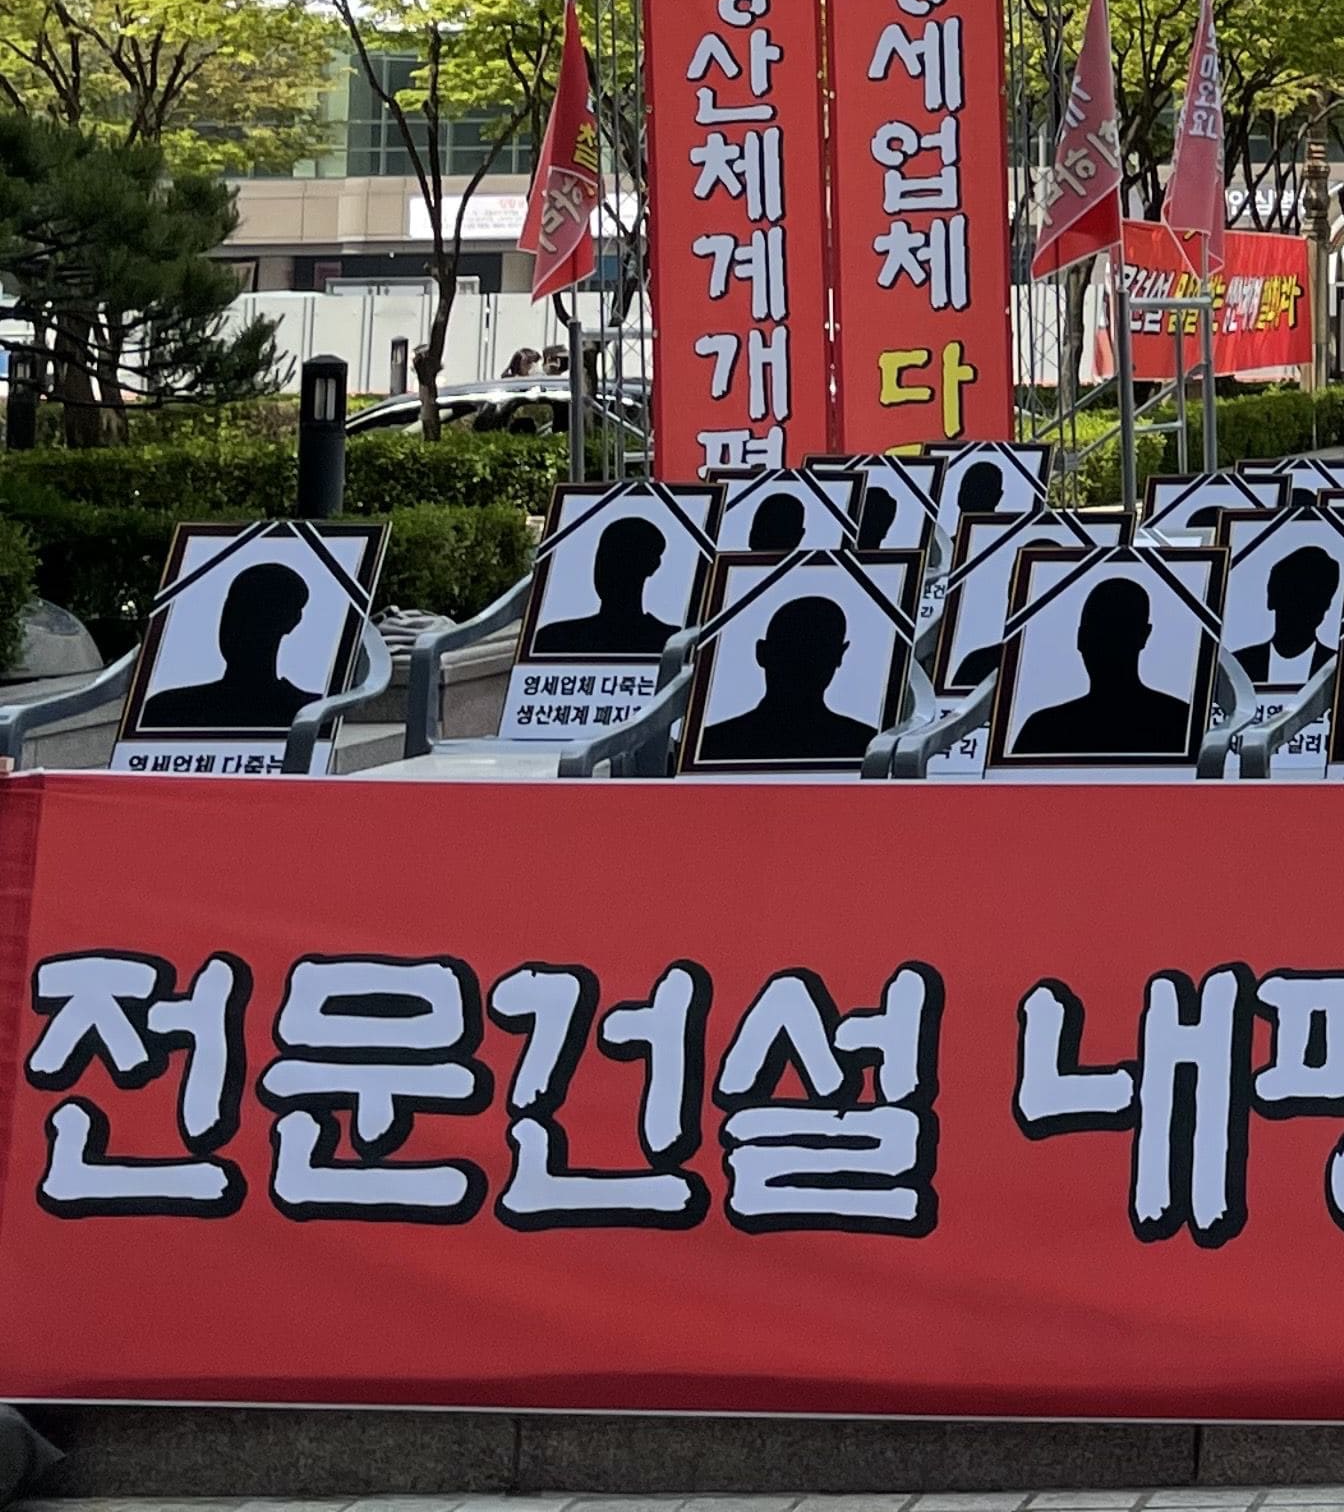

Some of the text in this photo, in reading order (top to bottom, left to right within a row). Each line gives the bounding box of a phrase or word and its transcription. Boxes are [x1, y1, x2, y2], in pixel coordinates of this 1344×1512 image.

[878, 340, 975, 456] 다
[516, 704, 590, 726] 생산체계
[524, 675, 655, 696] 영세업체 다죽는
[28, 951, 937, 1232] 전문건설
